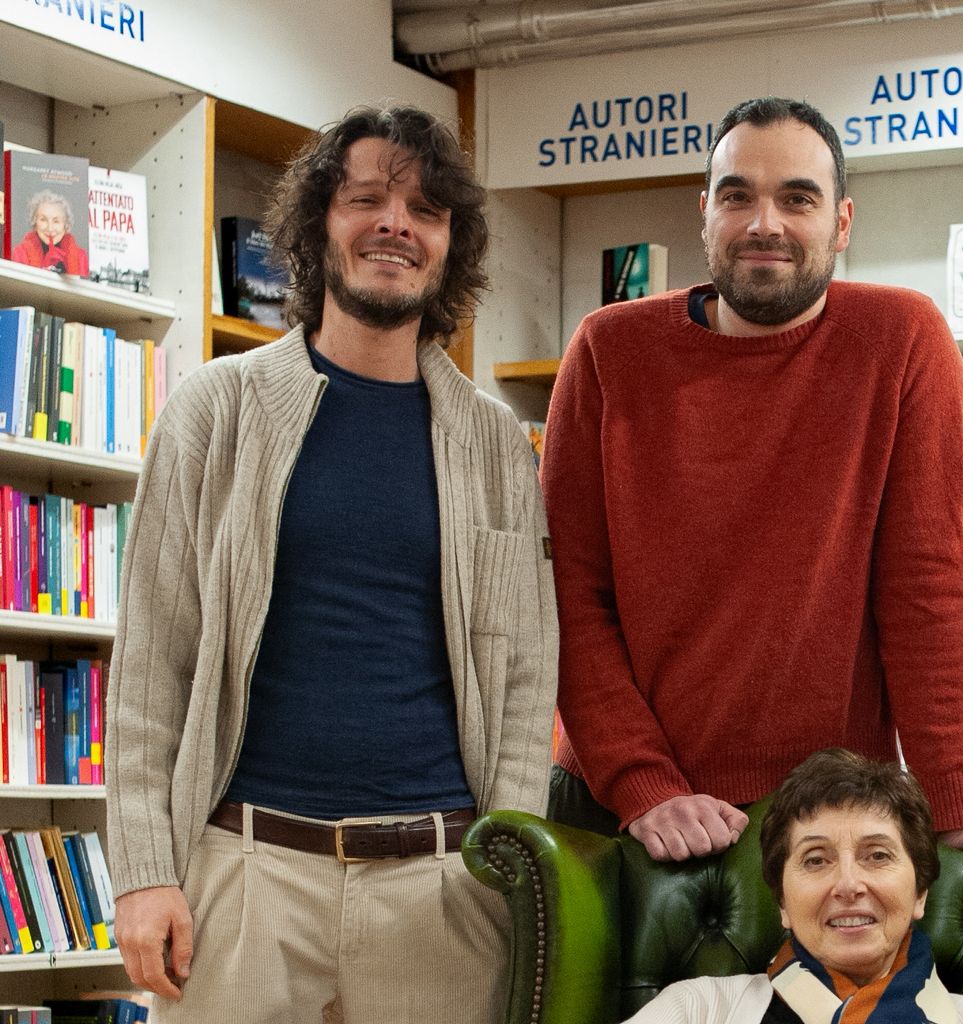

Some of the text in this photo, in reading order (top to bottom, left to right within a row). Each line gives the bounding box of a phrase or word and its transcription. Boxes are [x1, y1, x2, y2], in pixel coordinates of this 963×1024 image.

[34, 0, 144, 41] NIERI
[568, 91, 688, 132] AUTORI
[538, 123, 714, 167] STRANIERI
[103, 210, 135, 234] PAPA
